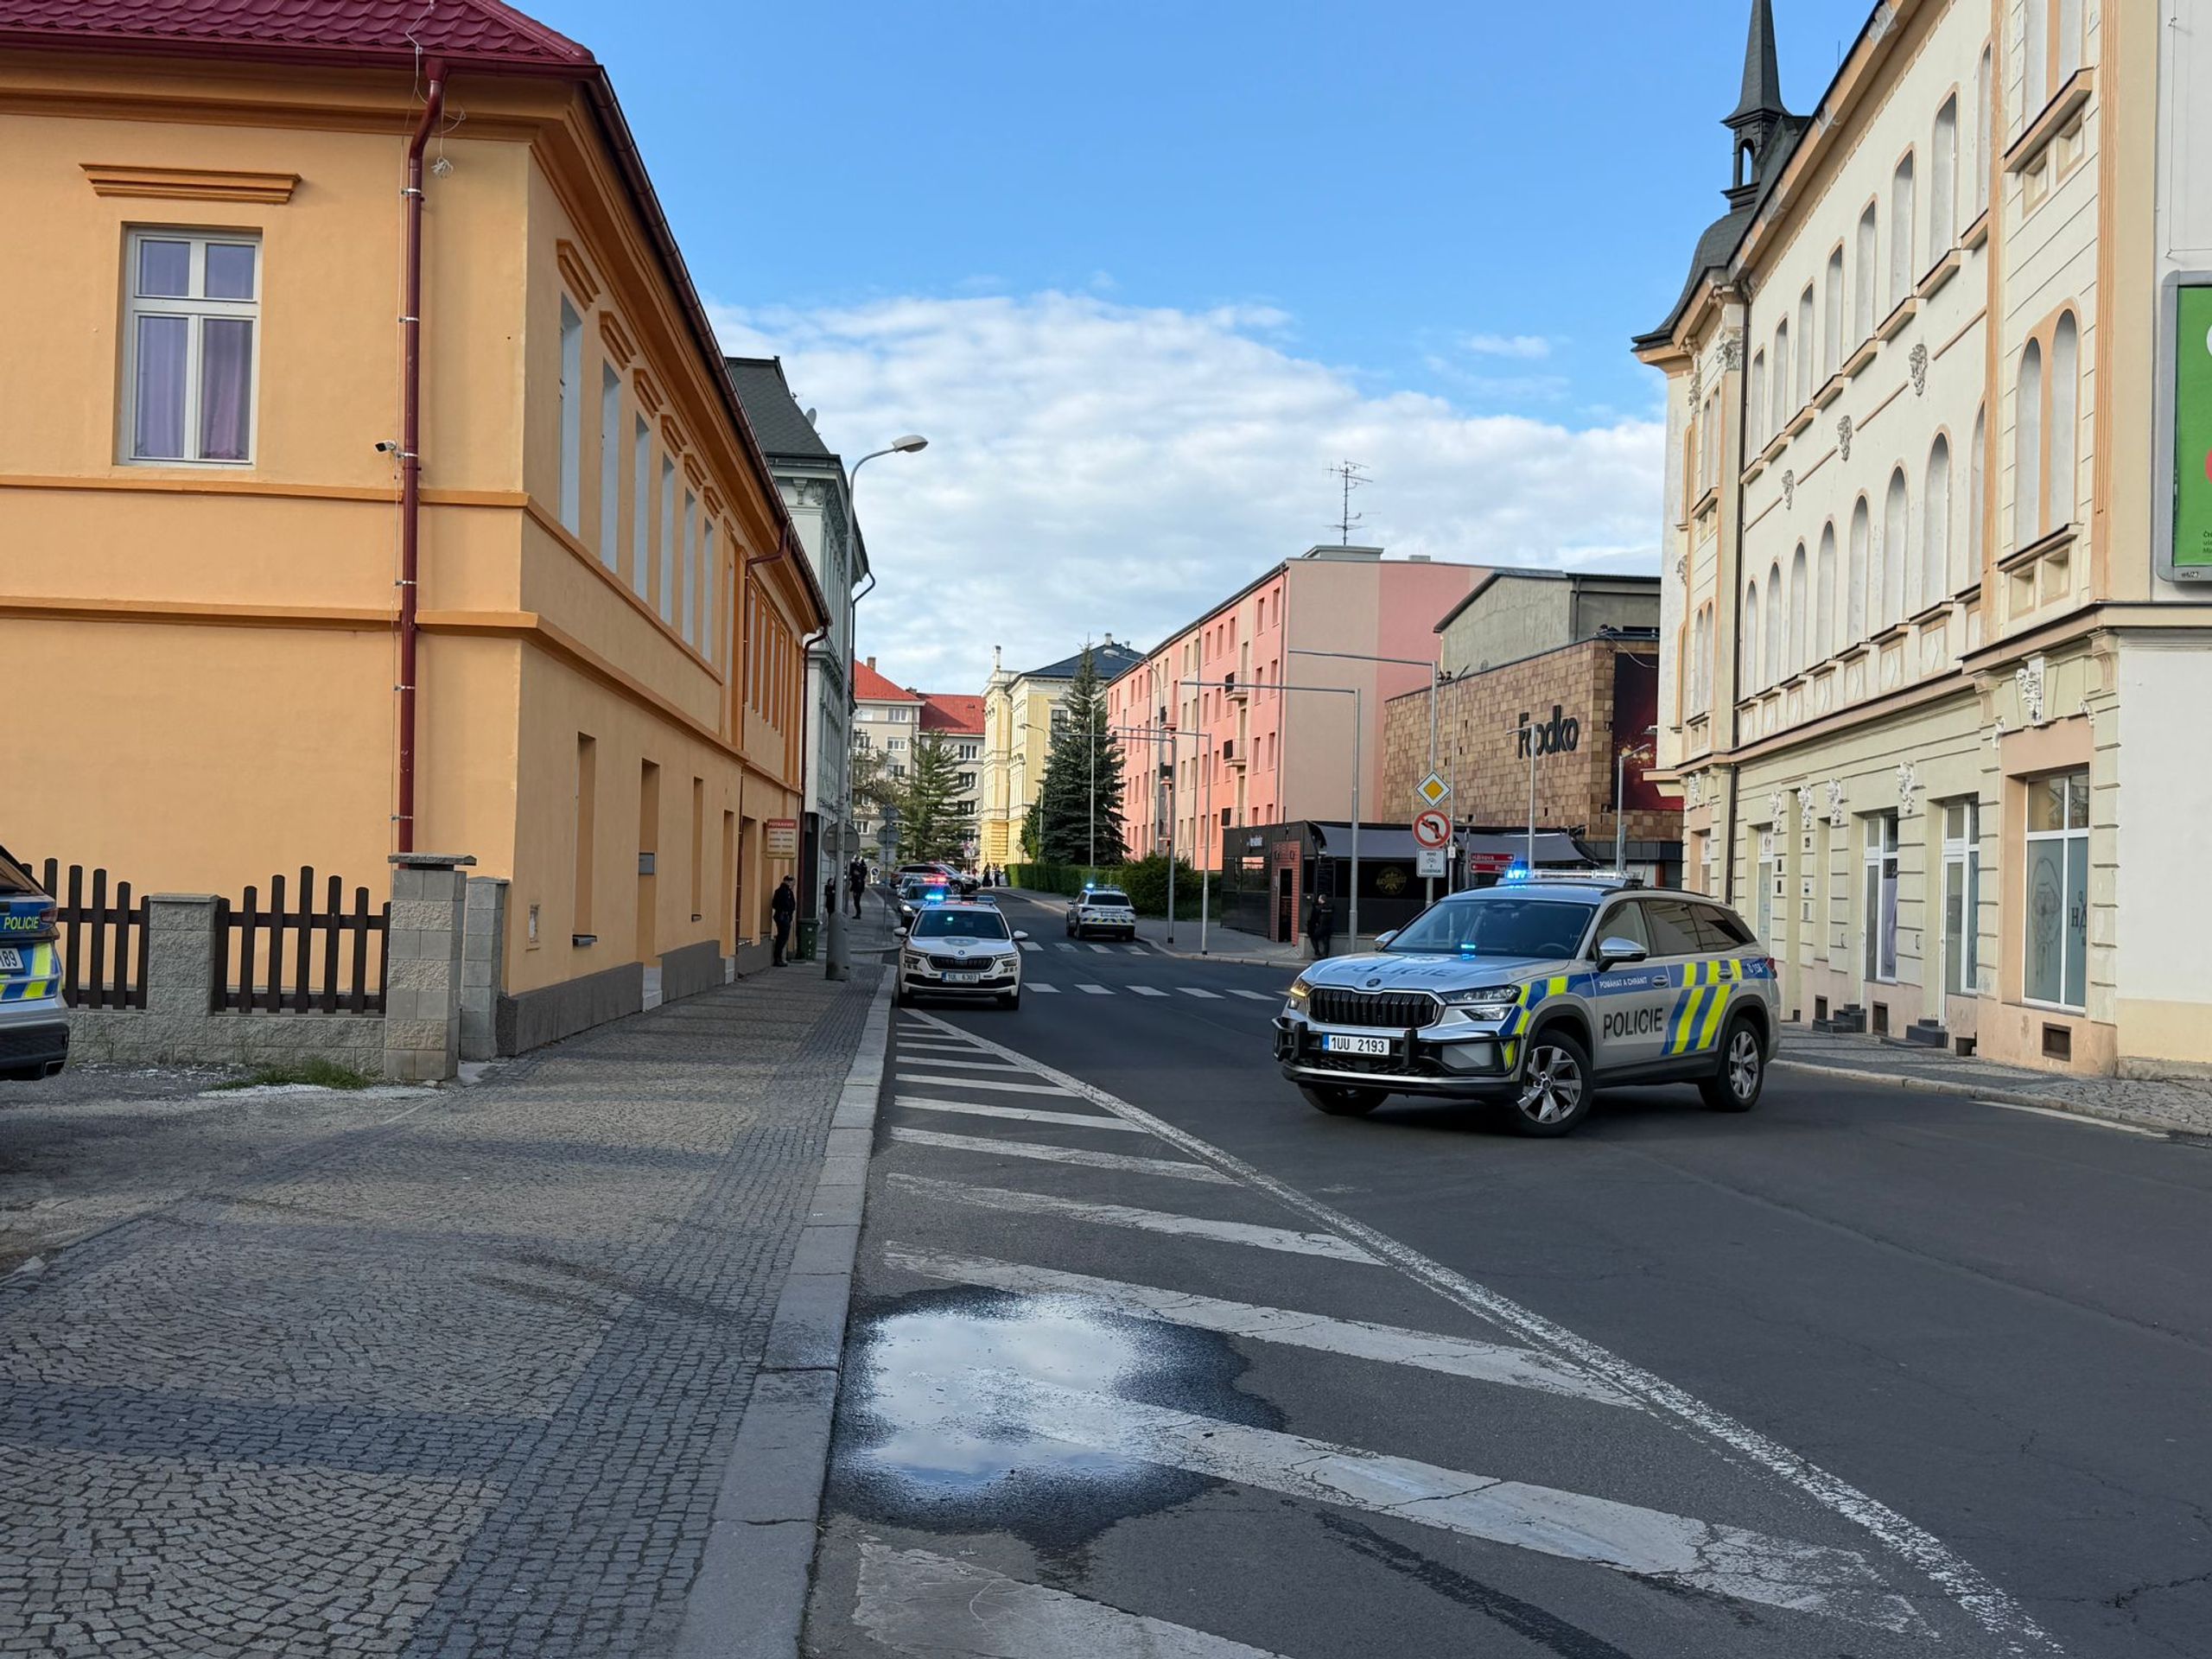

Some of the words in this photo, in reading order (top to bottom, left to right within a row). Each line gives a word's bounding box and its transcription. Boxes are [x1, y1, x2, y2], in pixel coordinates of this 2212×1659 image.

[3, 916, 40, 931] POLICIE
[1332, 964, 1457, 977] POLICIE
[1599, 978, 1623, 988] POMÁHAT
[1603, 1007, 1664, 1039] POLICIE
[1332, 1037, 1351, 1051] 1UU
[1357, 1039, 1385, 1053] 2193
